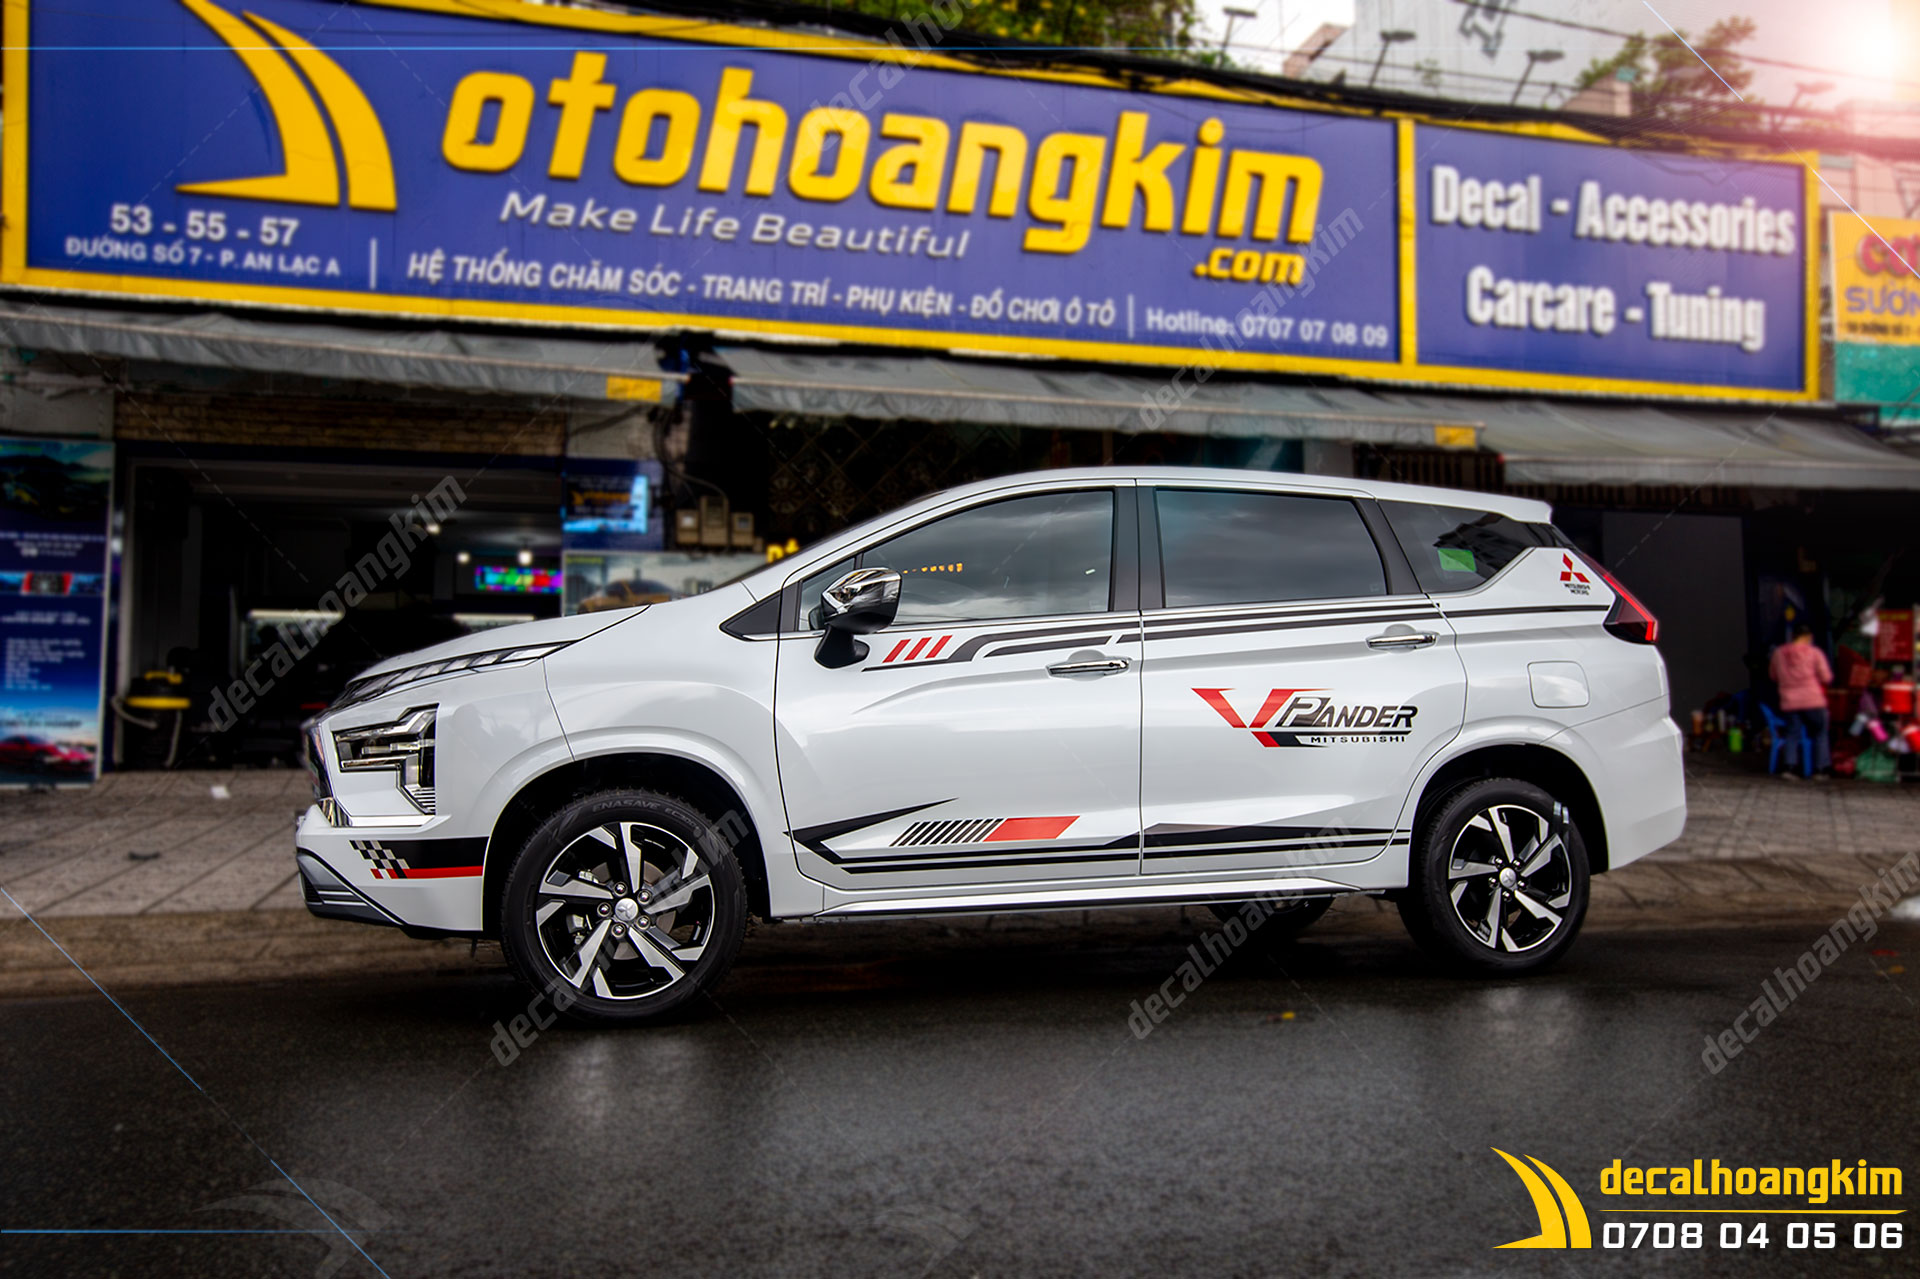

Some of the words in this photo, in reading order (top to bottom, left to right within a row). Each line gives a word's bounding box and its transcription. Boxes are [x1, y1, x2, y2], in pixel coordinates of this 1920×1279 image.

[442, 51, 1323, 253] otohoangkim
[111, 203, 152, 234] 53
[186, 210, 227, 241] 55
[260, 216, 299, 246] 57
[500, 192, 638, 232] Make
[650, 204, 740, 240] Life
[752, 213, 970, 259] Beautiful
[1432, 165, 1541, 232] Decal
[1576, 181, 1796, 254] Accessories
[65, 234, 147, 262] ĐƯỜNG
[153, 238, 184, 264] SỐ
[189, 248, 202, 265] 7
[243, 252, 273, 271] AN
[278, 254, 320, 276] LẠC
[326, 258, 340, 276] A
[1194, 247, 1306, 286] .com
[407, 248, 444, 284] HỆ
[453, 248, 542, 288] THỐNG
[549, 258, 623, 293] CHĂM
[628, 262, 681, 297] SÓC
[702, 274, 783, 303] TRANG
[790, 278, 831, 307] TRÍ
[846, 286, 894, 316] PHỤ
[900, 286, 952, 317] KIỆN
[1007, 297, 1060, 322] CHƠI
[1065, 297, 1082, 325] Ô
[1087, 299, 1116, 327] TÔ
[1467, 266, 1616, 335] Carcare
[1647, 281, 1765, 351] Tuning
[1146, 307, 1236, 337] Hotline:
[1241, 314, 1294, 339] 0707
[1299, 319, 1326, 343] 07
[1331, 322, 1357, 346] 08
[1362, 325, 1389, 348] 09
[1310, 735, 1406, 744] MITSUBISHI
